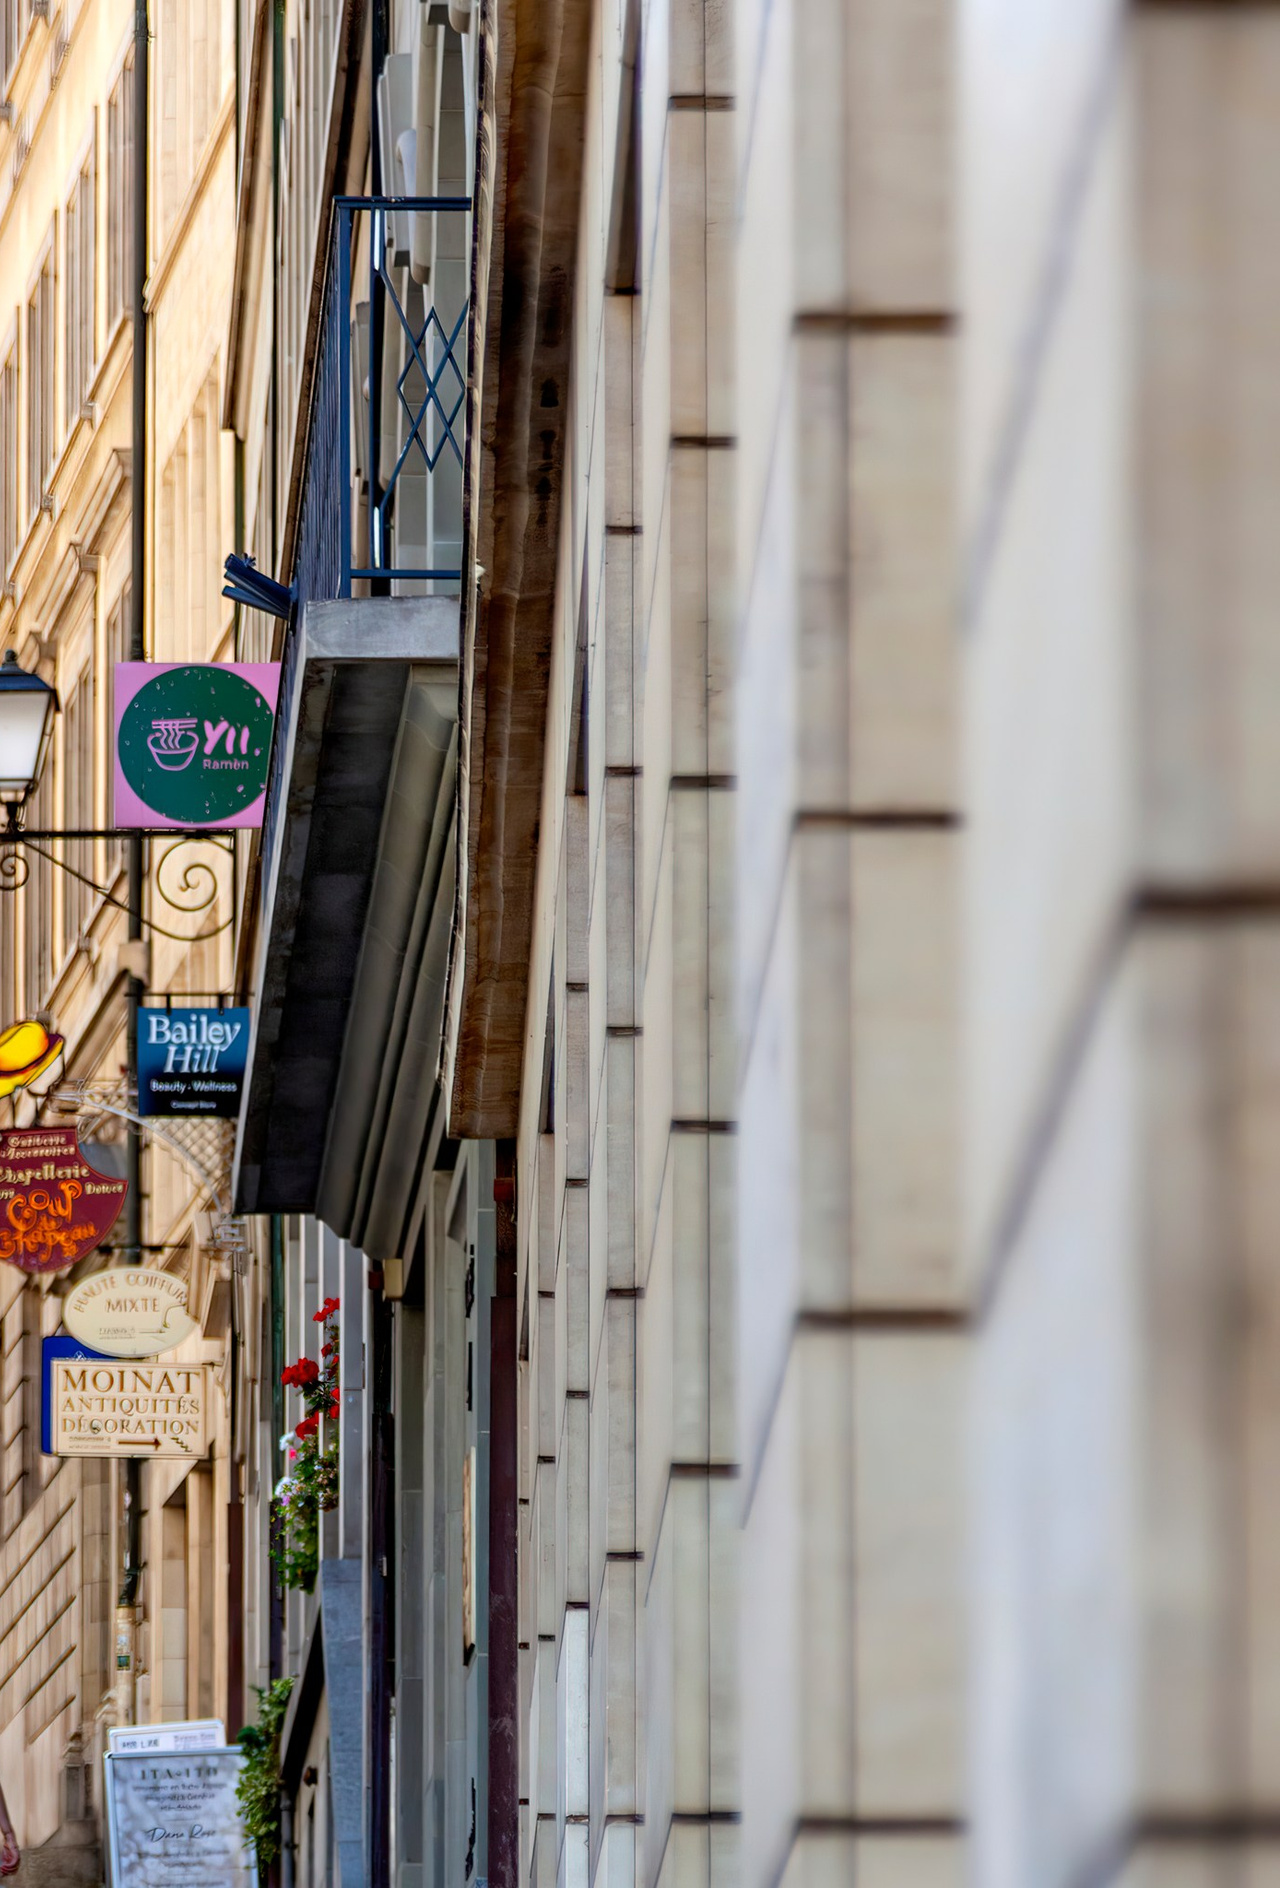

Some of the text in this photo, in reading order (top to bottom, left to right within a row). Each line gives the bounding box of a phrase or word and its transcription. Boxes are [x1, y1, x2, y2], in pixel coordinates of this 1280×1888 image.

[147, 1013, 241, 1052] Bailey
[163, 1044, 220, 1074] Hill
[125, 1272, 188, 1303] COIFFUR
[106, 1297, 160, 1313] MIXTE
[62, 1369, 201, 1394] MOINAT
[62, 1395, 200, 1416] ANTIQUITÉS
[62, 1415, 200, 1434] DÉCORATION
